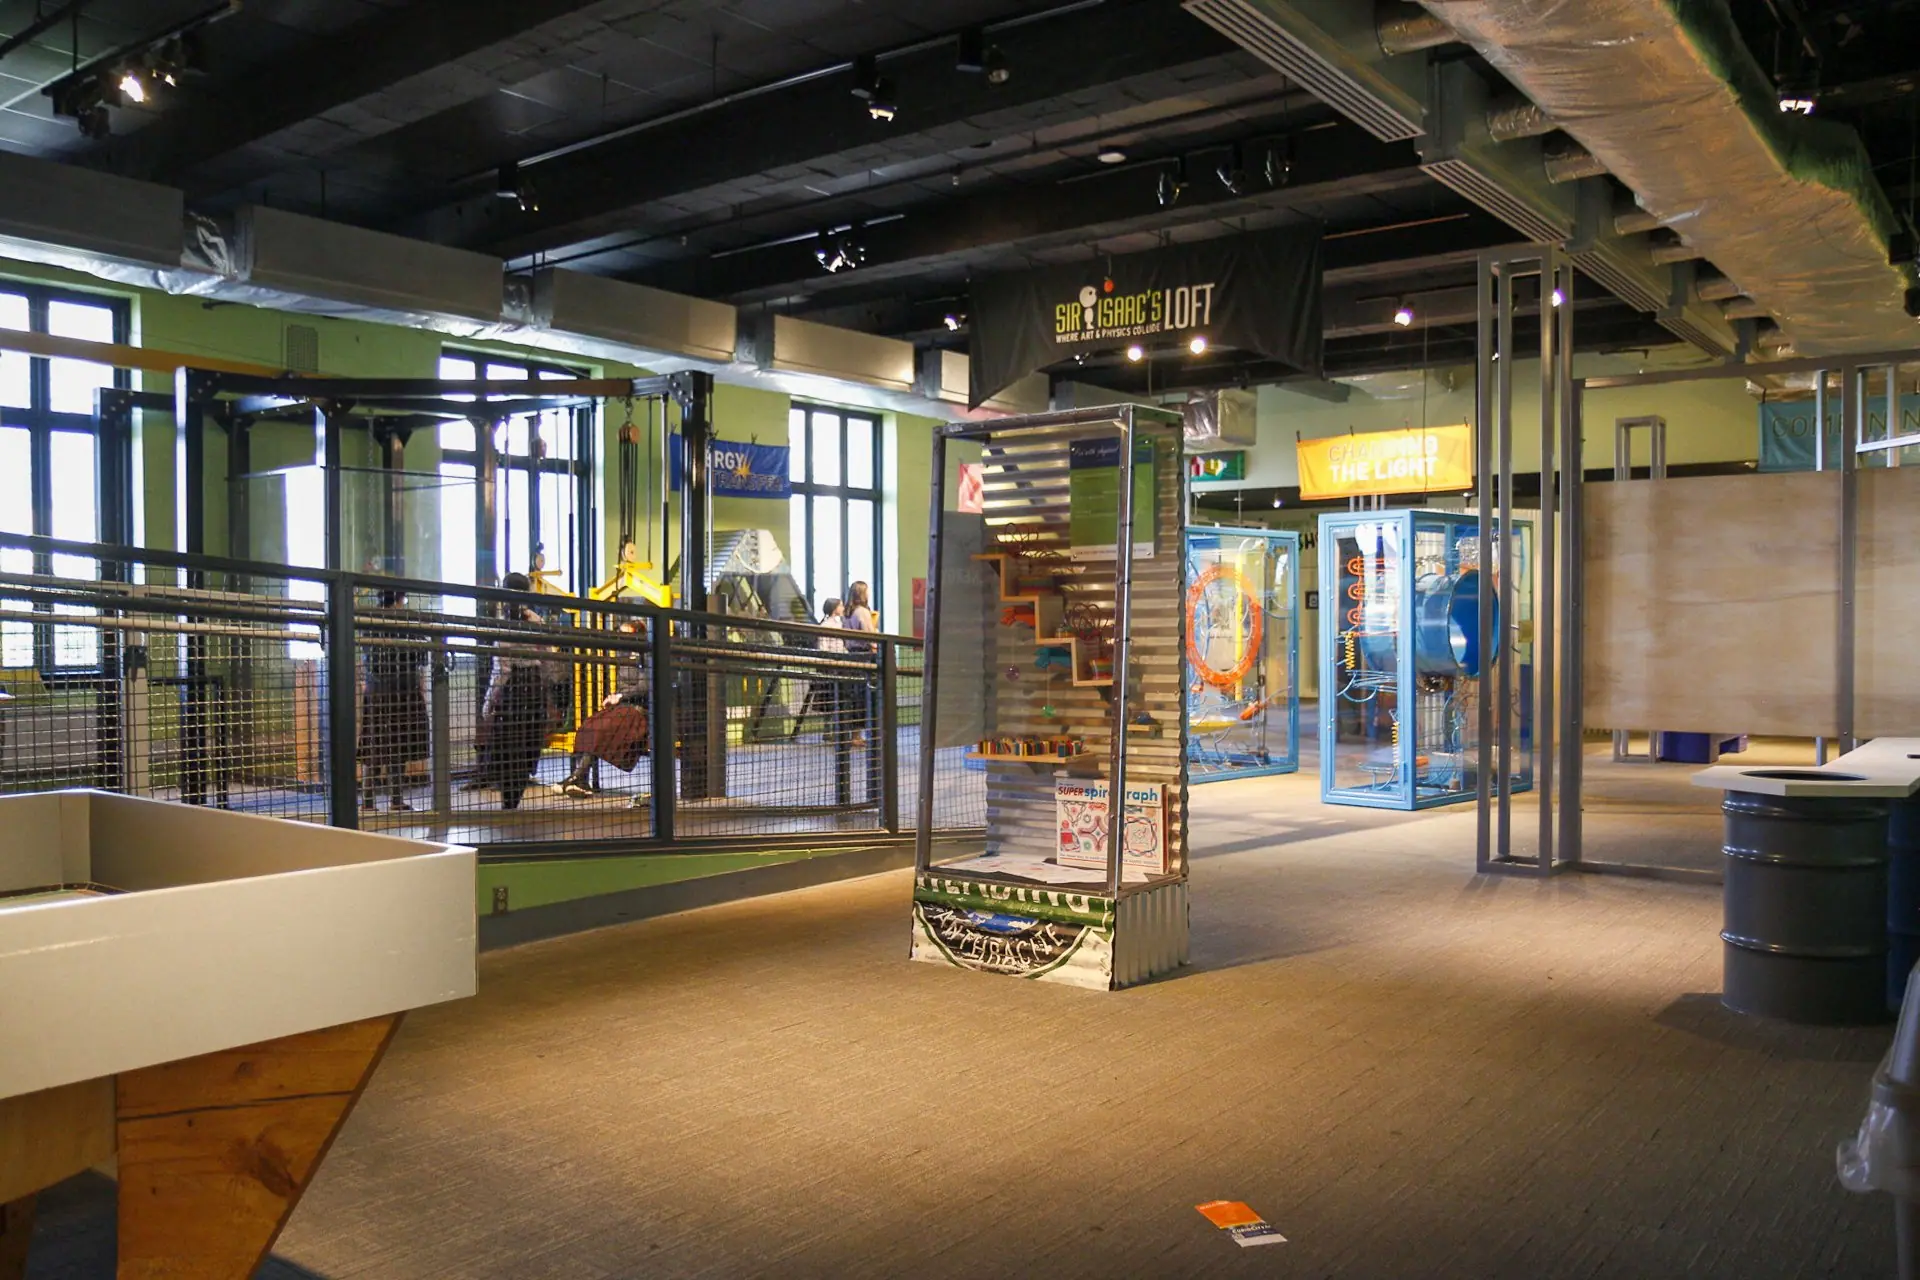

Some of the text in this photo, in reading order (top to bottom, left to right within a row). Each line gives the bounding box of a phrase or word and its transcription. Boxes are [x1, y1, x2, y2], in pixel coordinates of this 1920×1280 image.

[1055, 283, 1215, 333] SIR ISAAC'S LOFT
[1055, 323, 1161, 343] WHERE ART & PHYSICS COLLIDE
[1329, 435, 1439, 464] CHANING
[1329, 457, 1439, 483] THE LIGHT
[1084, 785, 1158, 804] spirraph
[932, 909, 1065, 966] ANTHRACITE
